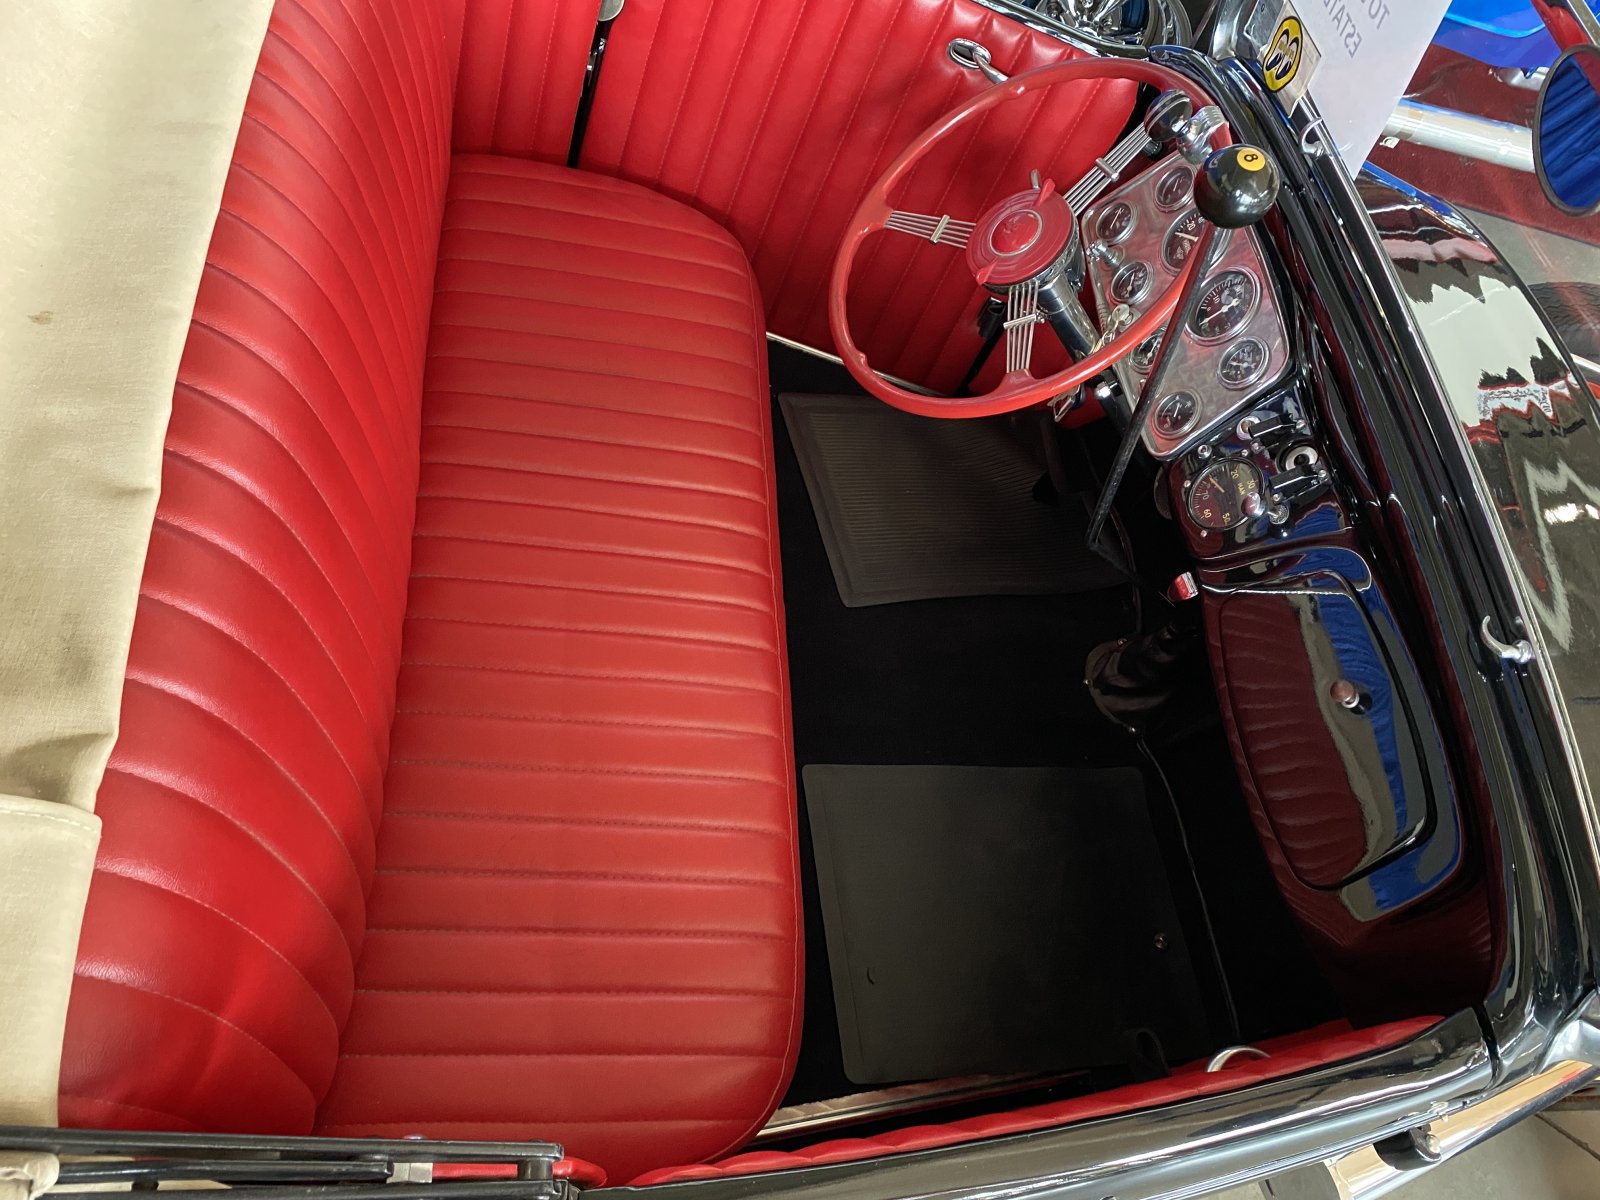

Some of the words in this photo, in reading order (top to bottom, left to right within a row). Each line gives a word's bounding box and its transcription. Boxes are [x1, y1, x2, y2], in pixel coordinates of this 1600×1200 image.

[1244, 154, 1258, 162] 8
[1231, 469, 1239, 479] 20
[1247, 479, 1256, 489] 30
[1202, 490, 1209, 500] 70
[1203, 508, 1212, 518] 60
